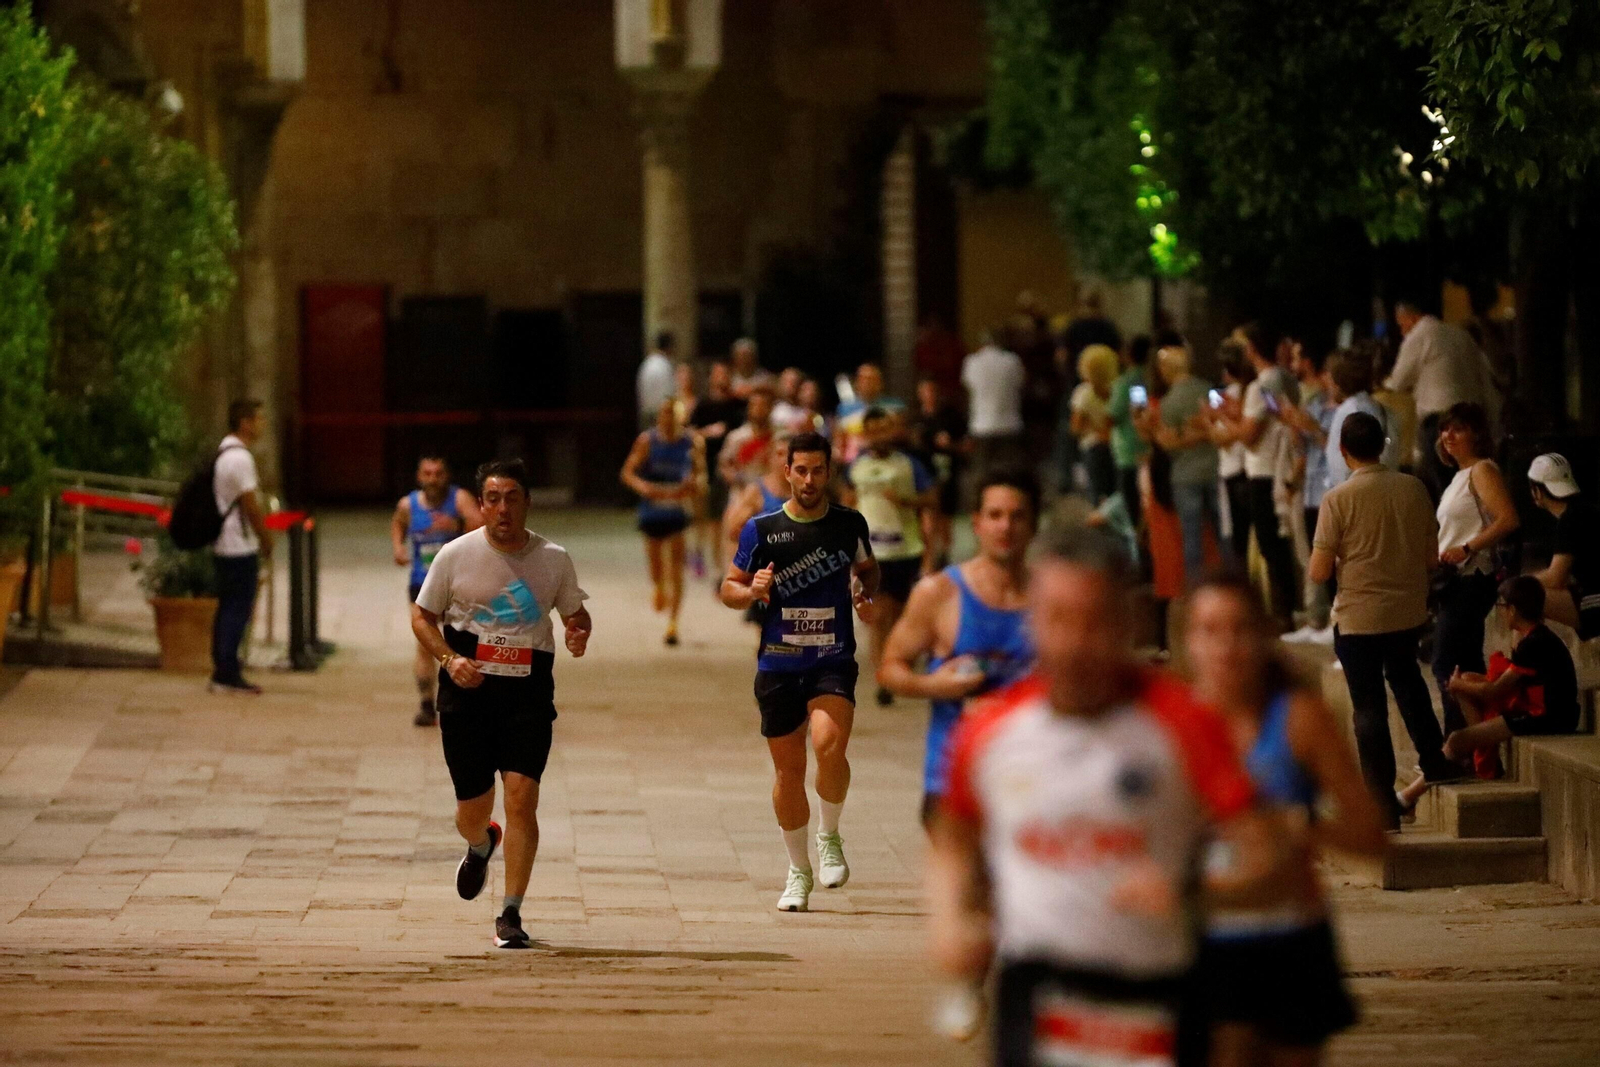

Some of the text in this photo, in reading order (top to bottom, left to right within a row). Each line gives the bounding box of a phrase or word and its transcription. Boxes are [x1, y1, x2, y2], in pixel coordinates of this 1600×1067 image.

[774, 546, 828, 585] RUNNING
[777, 549, 851, 599] ALCOLEA
[797, 610, 808, 618] 20
[793, 620, 825, 632] 1044
[494, 636, 506, 646] 20
[492, 647, 519, 661] 290
